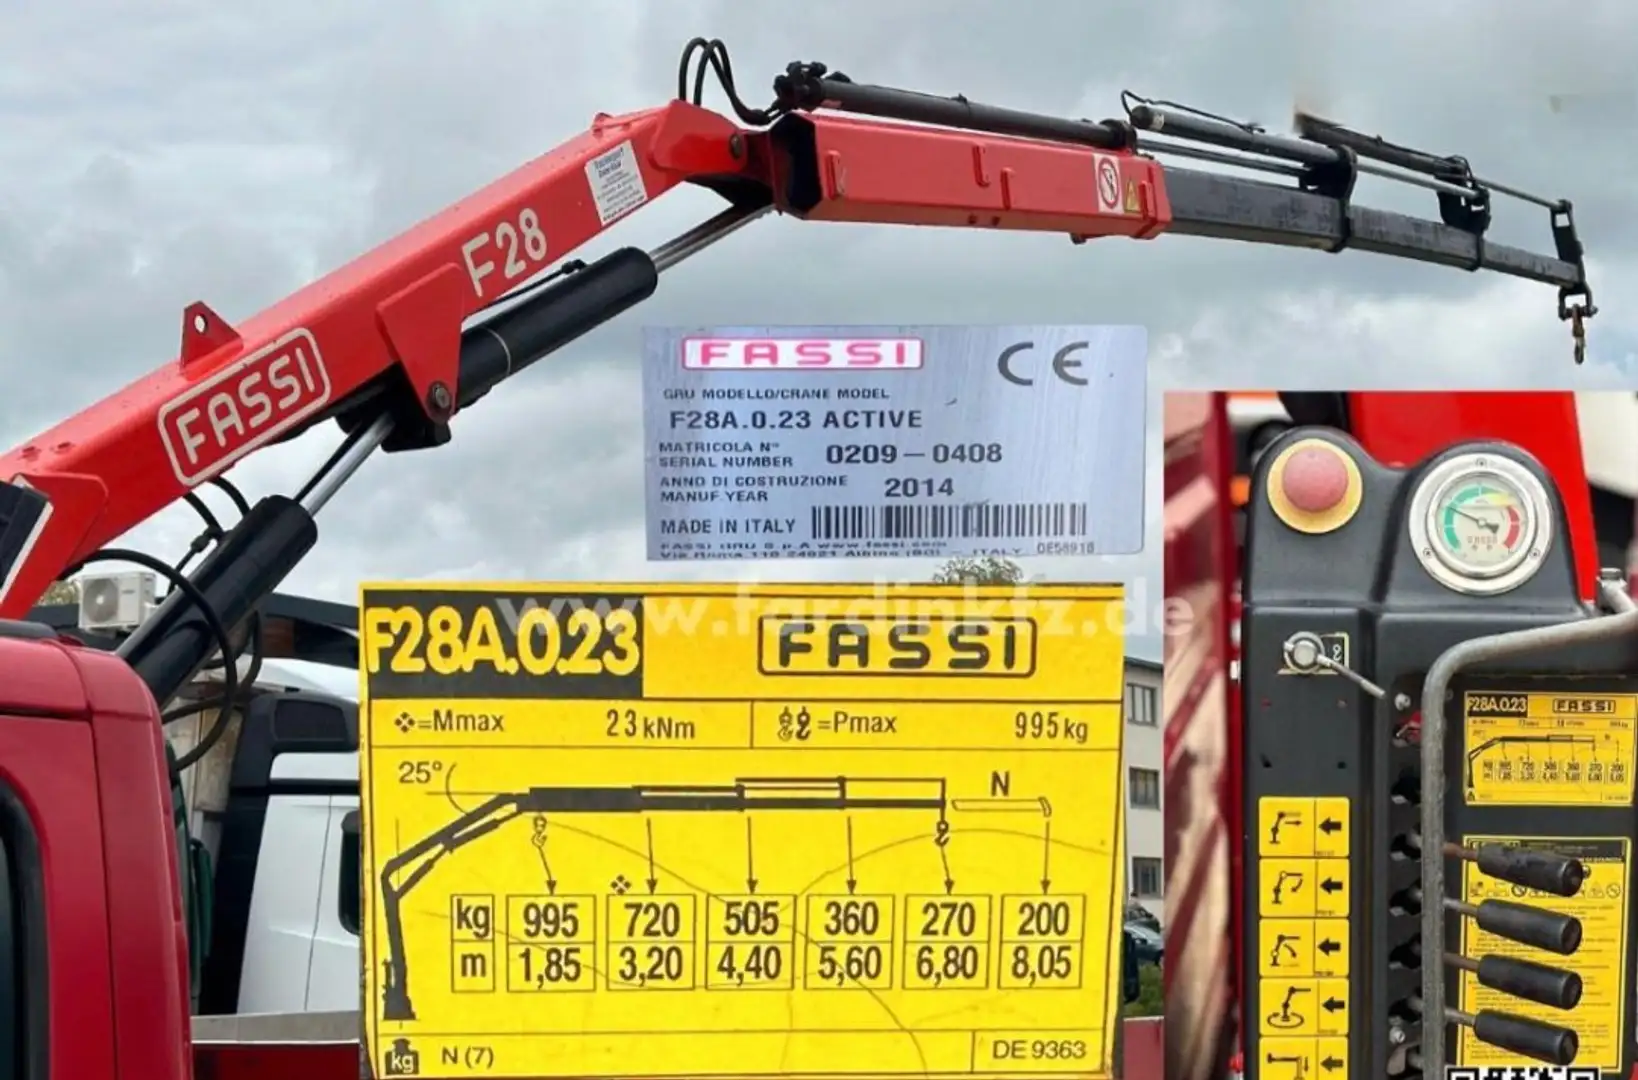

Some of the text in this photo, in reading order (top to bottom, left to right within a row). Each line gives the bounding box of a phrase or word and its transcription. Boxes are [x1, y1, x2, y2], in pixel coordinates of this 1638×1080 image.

[462, 208, 547, 297] F28
[701, 341, 906, 366] FASSI
[176, 347, 316, 465] FASSI
[663, 388, 890, 400] GRU MODELLO/CRANE MODEL
[670, 410, 922, 429] F28A.0.23 ACTIVE
[659, 441, 753, 453] MATRICOLA
[659, 456, 793, 468] SERIAL NUMBER
[659, 475, 849, 487] ANNO DI COSTRUZIONE
[884, 477, 954, 498] 2014
[660, 518, 796, 535] MADE IN ITALY
[779, 622, 1016, 671] FASSI
[1556, 699, 1613, 713] FASSI
[643, 715, 696, 740] kNm
[1014, 711, 1088, 743] 995 kg
[398, 760, 443, 785] 25°
[990, 770, 1010, 796] N
[456, 897, 1069, 938] kg 995 720 505 360 270 200
[460, 944, 1072, 990] m 1,85 3,20 4,40 5,60 6,80 8,05
[441, 1045, 494, 1069] N (7)
[992, 1039, 1087, 1060] DE 9363
[390, 1051, 415, 1075] kg
